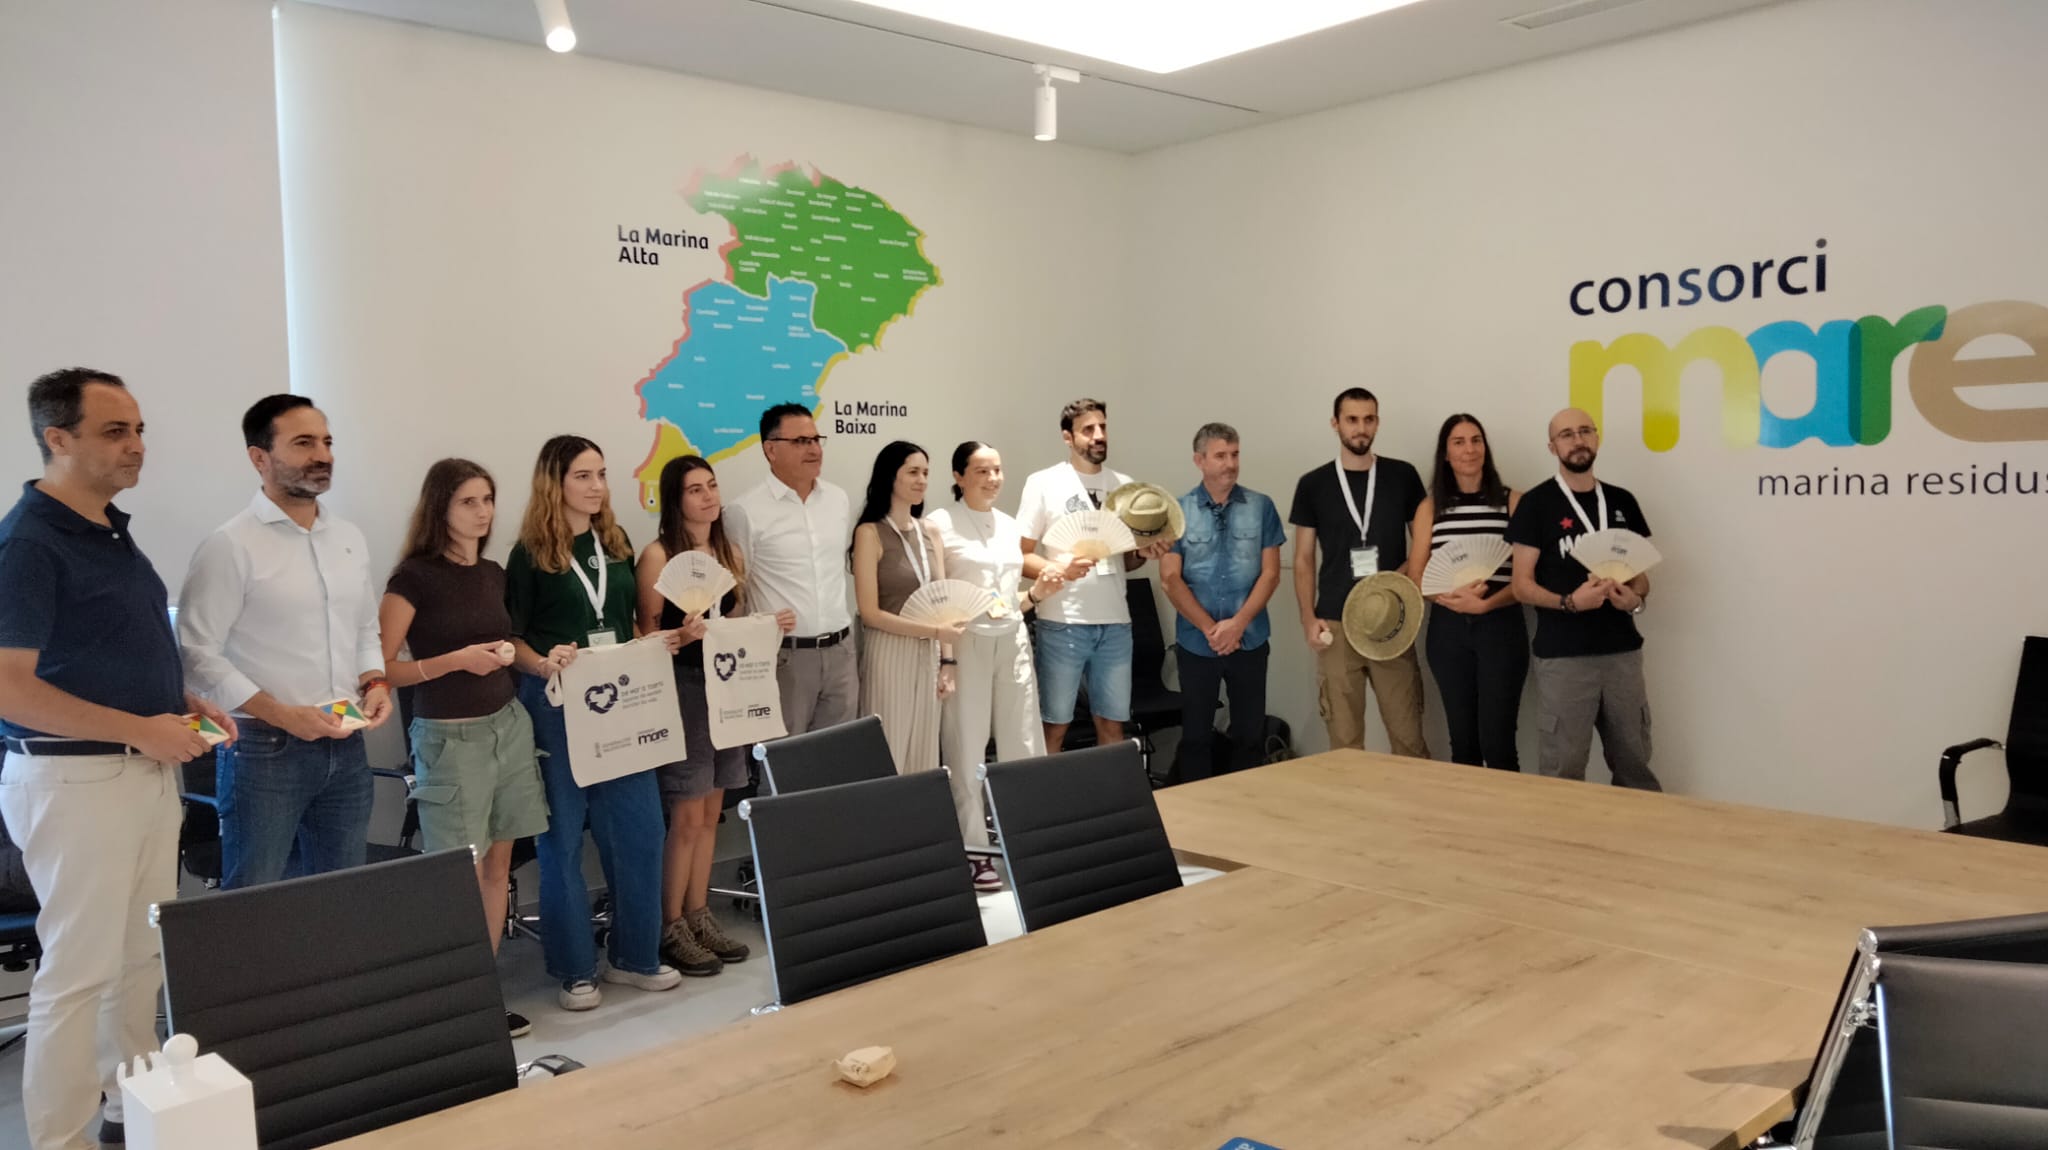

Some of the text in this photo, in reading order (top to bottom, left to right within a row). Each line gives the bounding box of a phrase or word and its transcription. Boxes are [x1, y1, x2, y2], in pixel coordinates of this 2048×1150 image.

[618, 224, 709, 250] La Marina
[618, 246, 659, 266] Alta
[1569, 238, 1828, 316] consorci
[1569, 300, 2048, 453] mare
[834, 400, 908, 417] La Marina
[835, 418, 877, 435] Baixa
[1758, 462, 2048, 497] marina residu
